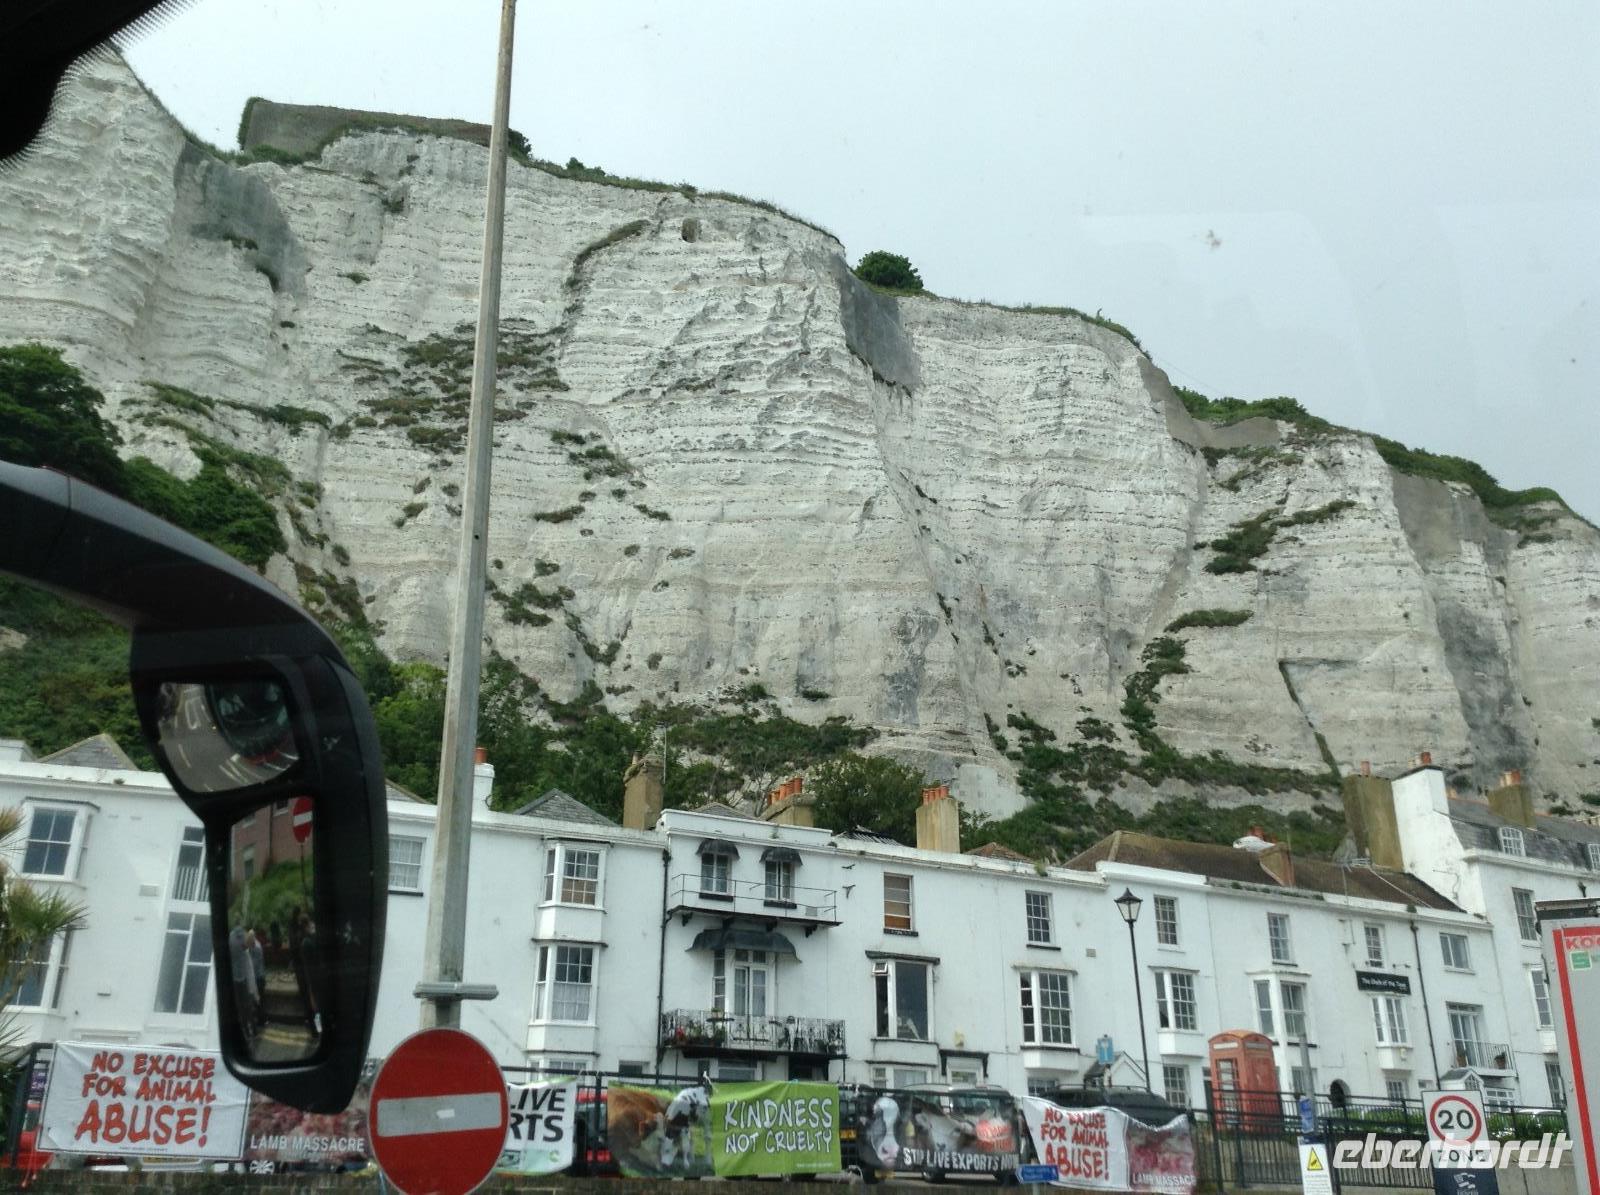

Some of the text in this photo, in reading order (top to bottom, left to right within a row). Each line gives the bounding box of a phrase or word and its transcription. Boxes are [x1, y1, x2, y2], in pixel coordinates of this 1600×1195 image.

[1565, 936, 1600, 950] KO
[91, 1051, 216, 1079] NO EXCUSE
[82, 1073, 216, 1103] FOR ANIMAL
[75, 1100, 211, 1147] ABUSE!
[724, 1097, 833, 1129] KINDNESS
[1044, 1107, 1063, 1123] NO
[1438, 1109, 1474, 1130] 20
[250, 1134, 365, 1152] LAMB MASSACRE
[726, 1128, 833, 1154] NOT CRUELTY
[1040, 1122, 1109, 1149] FOR ANIMAL
[926, 1149, 950, 1168] LIVE
[952, 1152, 999, 1170] EXPORTS
[1045, 1142, 1109, 1180] ABUSE!
